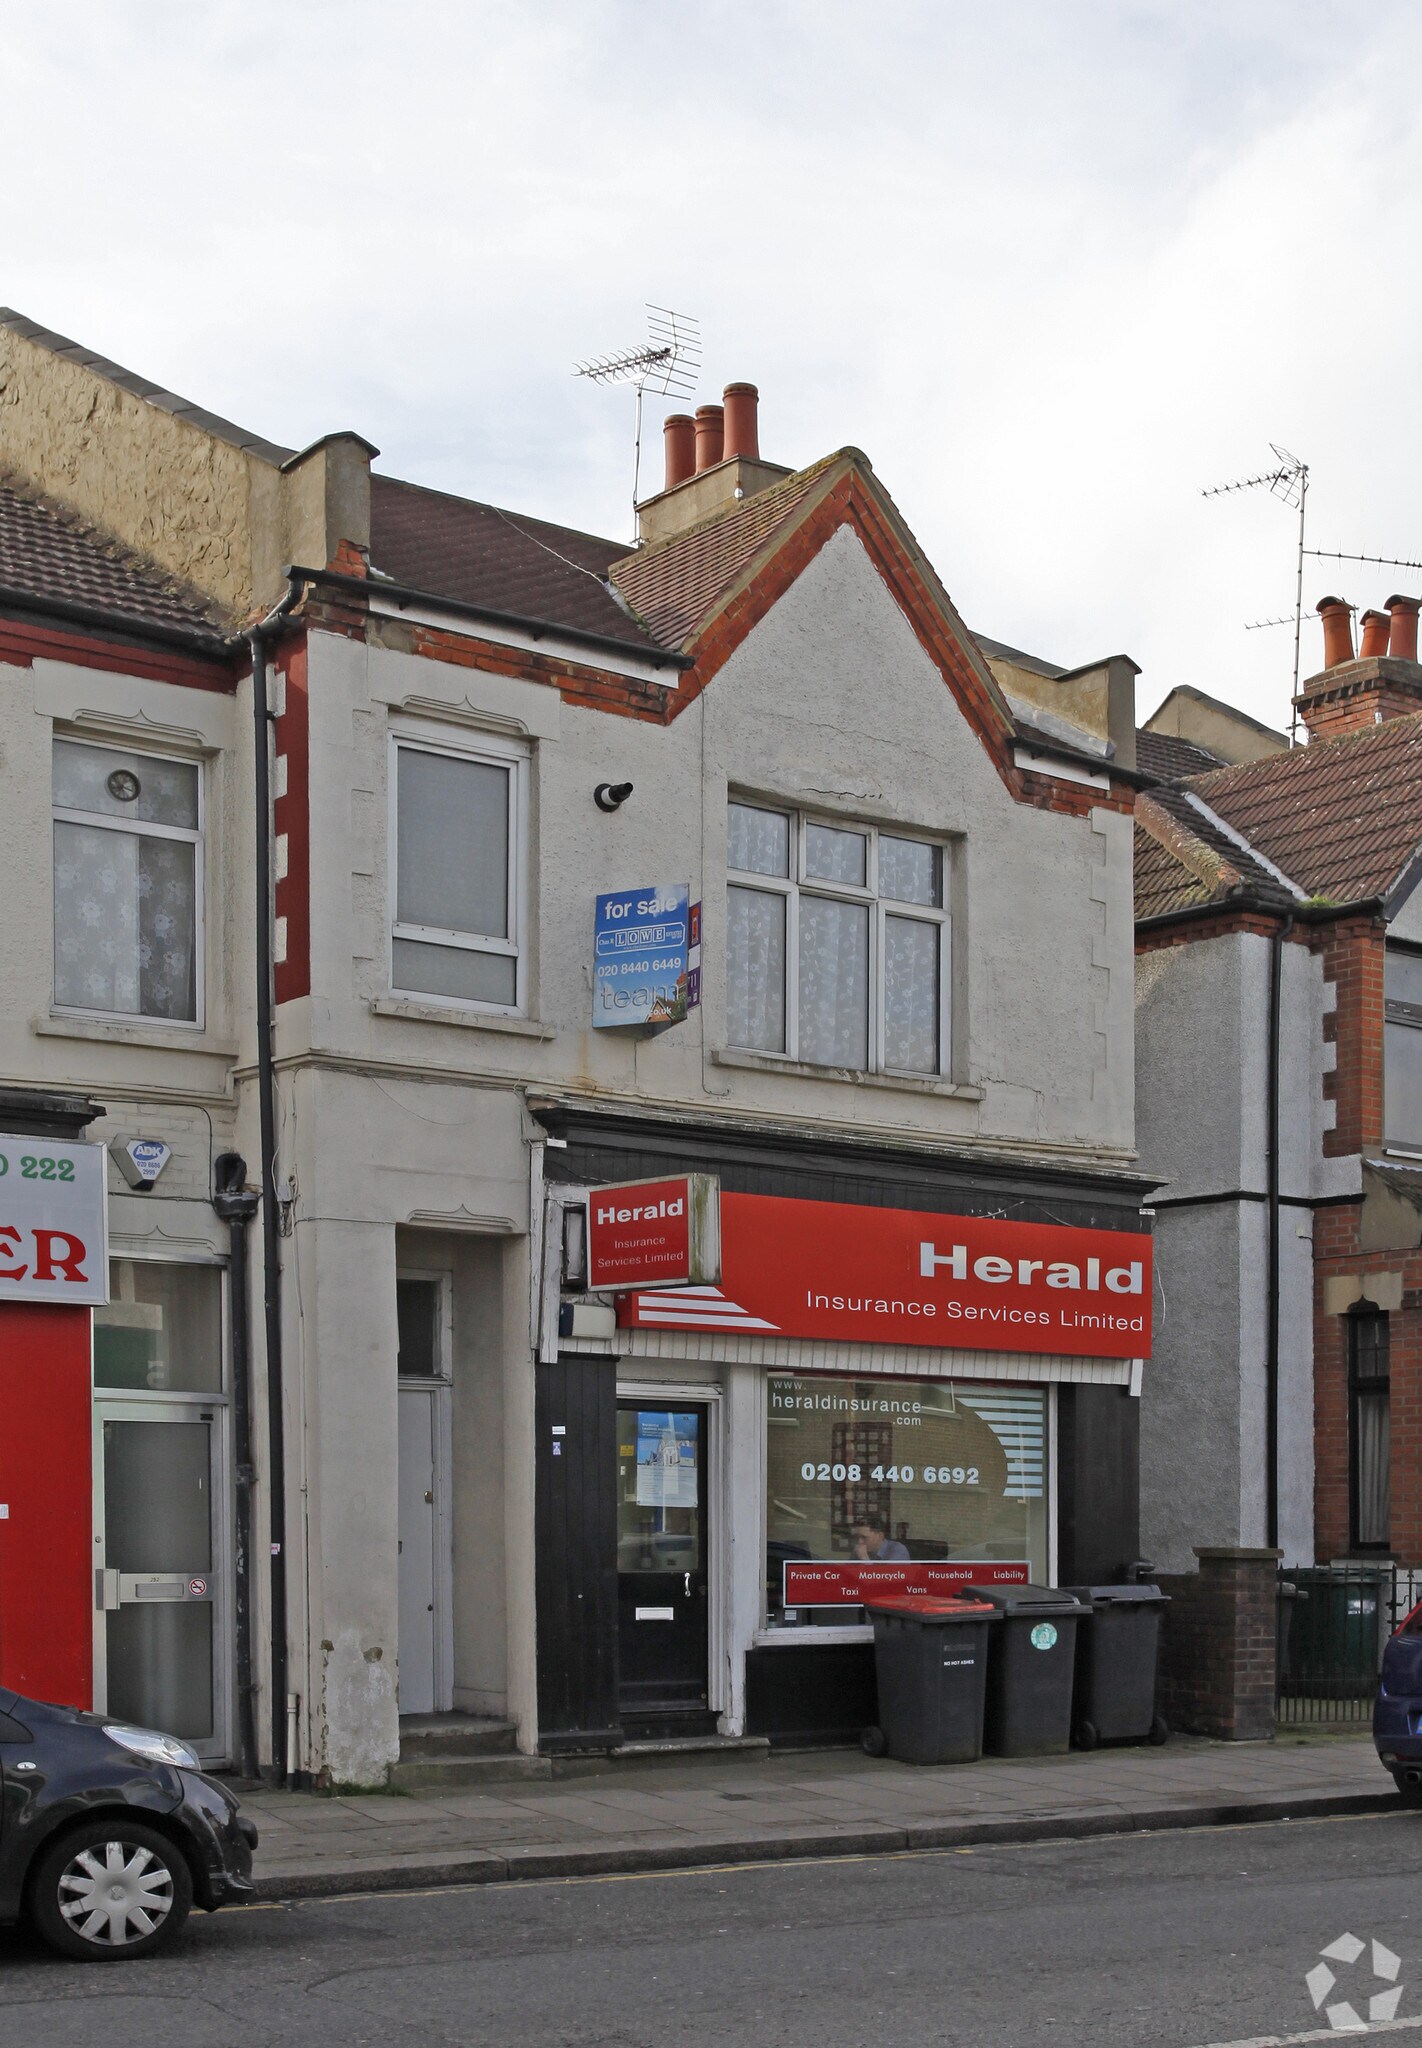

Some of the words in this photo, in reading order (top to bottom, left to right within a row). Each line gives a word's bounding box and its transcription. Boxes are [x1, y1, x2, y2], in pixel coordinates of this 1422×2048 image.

[605, 901, 632, 919] for
[637, 897, 677, 914] sale
[617, 928, 664, 946] LOWE
[597, 964, 618, 977] 020
[621, 960, 649, 975] 8440
[652, 957, 681, 971] 6449
[601, 984, 679, 1010] team
[20, 1156, 76, 1182] 222
[597, 1198, 683, 1225] Herald
[614, 1236, 666, 1249] Insurance
[597, 1257, 641, 1268] Services
[644, 1250, 684, 1264] Limited
[920, 1242, 1143, 1295] Herald
[807, 1290, 937, 1317] Insurance
[946, 1301, 1051, 1325] Services
[1060, 1310, 1144, 1333] Limited
[773, 1381, 806, 1390] www.
[772, 1392, 922, 1413] heraldinsurance
[892, 1416, 922, 1426] .com
[801, 1462, 862, 1482] 0208
[870, 1464, 915, 1483] 440
[923, 1466, 980, 1485] 6692
[790, 1570, 822, 1580] Private
[824, 1570, 841, 1581] Car
[858, 1570, 906, 1583] Motorcycle
[928, 1570, 973, 1580] Household
[993, 1570, 1025, 1583] Liability
[841, 1587, 859, 1596] Taxi
[906, 1585, 928, 1595] Vans
